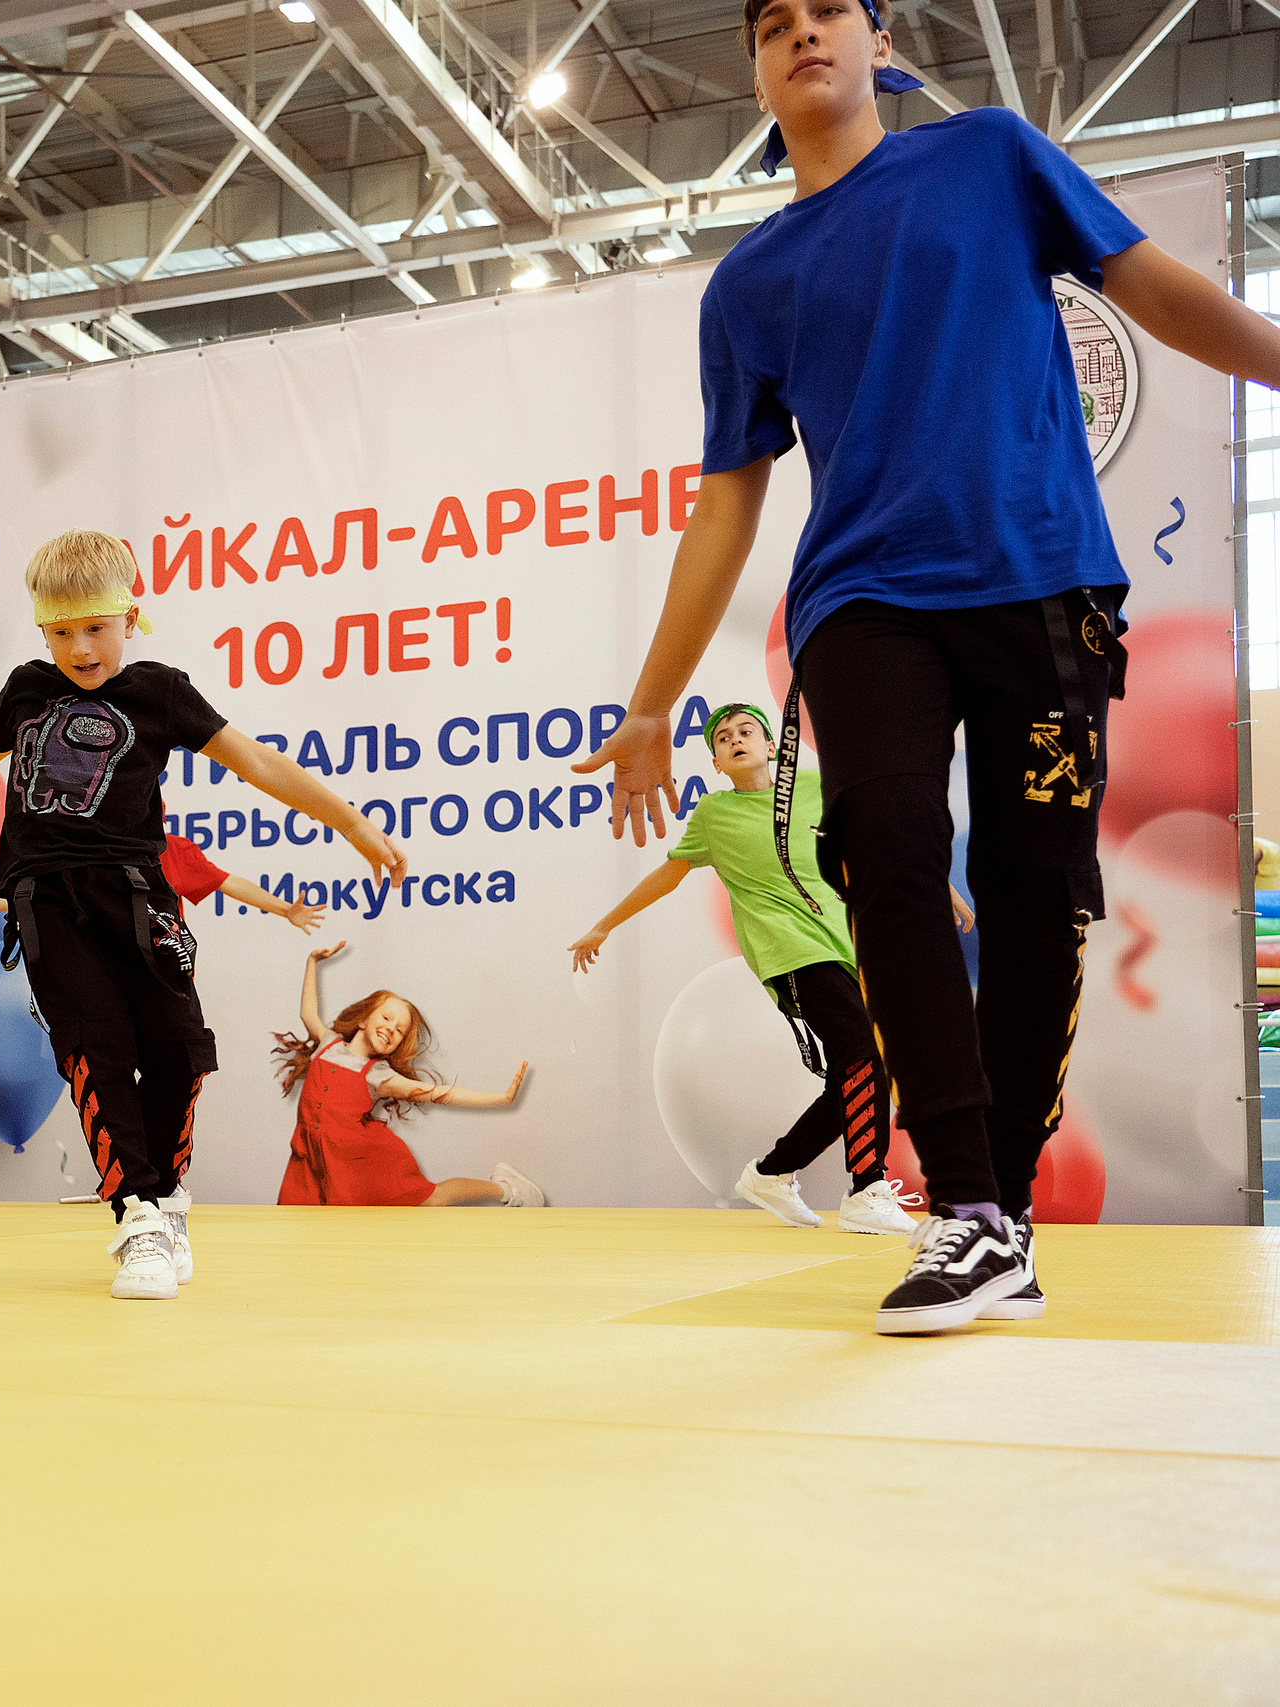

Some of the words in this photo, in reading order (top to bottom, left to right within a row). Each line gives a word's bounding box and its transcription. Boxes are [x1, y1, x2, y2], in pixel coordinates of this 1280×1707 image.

[121, 461, 702, 598] ЙКАЛ-АРЕНЕ
[213, 621, 303, 688] 10
[322, 597, 512, 679] ЛЕТ!
[437, 695, 712, 766] СПОРА
[775, 725, 798, 825] OFF-WHITE
[164, 793, 469, 851] БРЬСОГО
[483, 775, 708, 833] ОКРА
